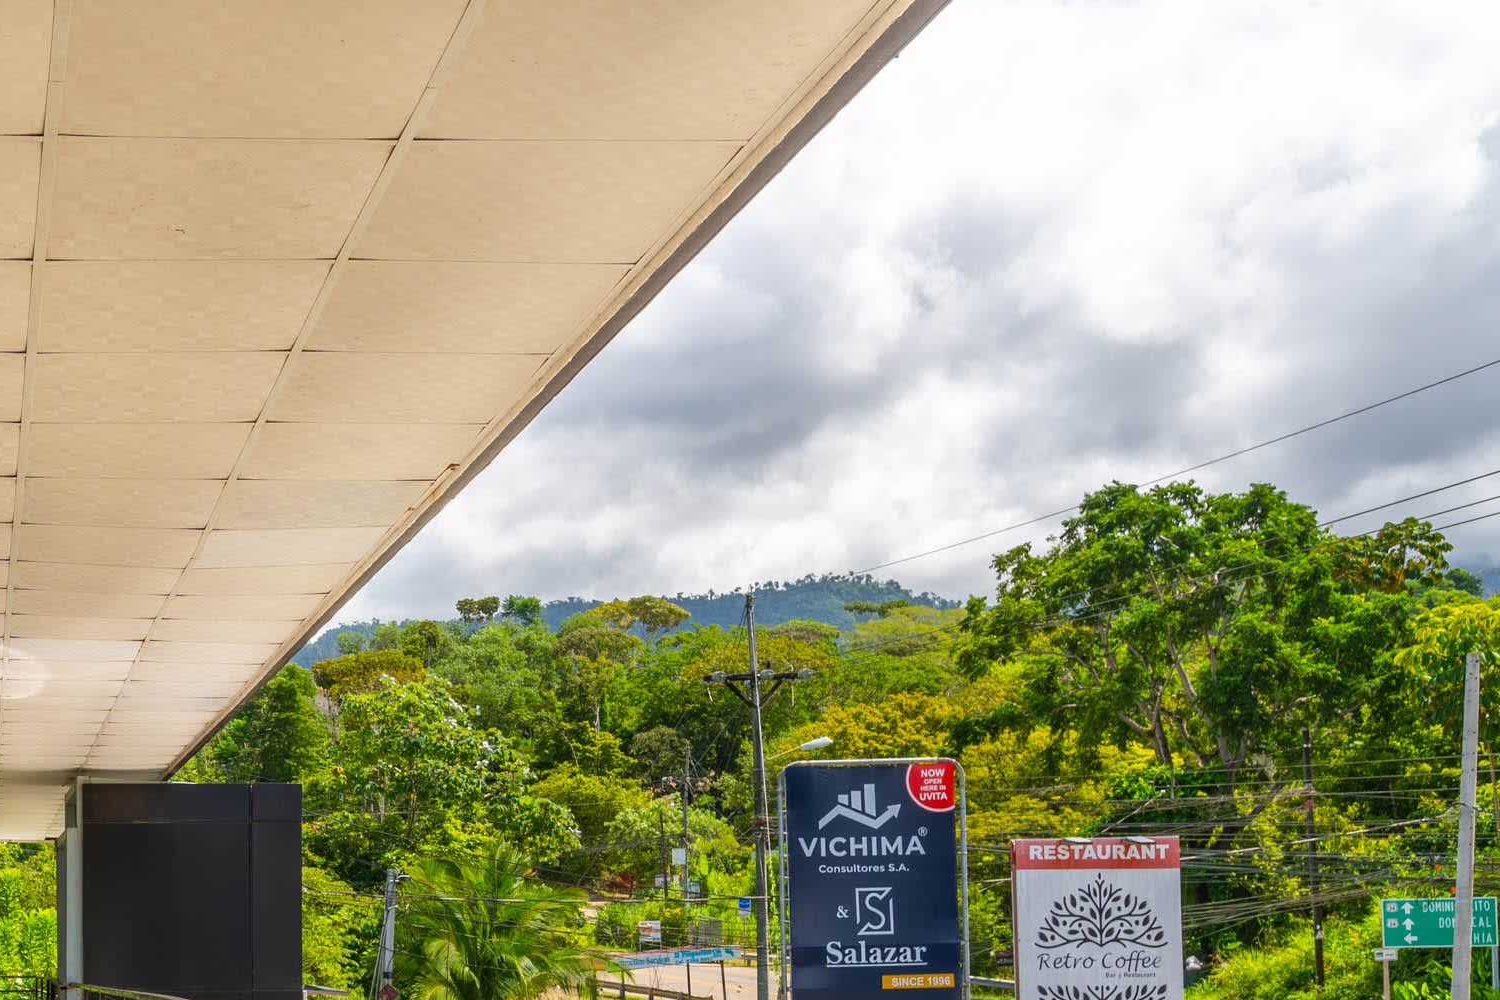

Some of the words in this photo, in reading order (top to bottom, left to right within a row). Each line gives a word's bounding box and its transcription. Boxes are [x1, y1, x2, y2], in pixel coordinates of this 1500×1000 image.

[921, 768, 945, 777] NOW
[920, 792, 948, 801] UVITA
[798, 836, 926, 857] VICHIMA
[1029, 844, 1170, 860] RESTAURANT
[818, 863, 885, 873] Consultores
[888, 863, 910, 872] S.A.
[837, 905, 849, 918] &
[826, 941, 927, 964] Salazar
[1037, 952, 1097, 970] Retro
[1102, 950, 1162, 972] Coffee
[892, 976, 924, 987] SINCE
[927, 976, 951, 986] 1996
